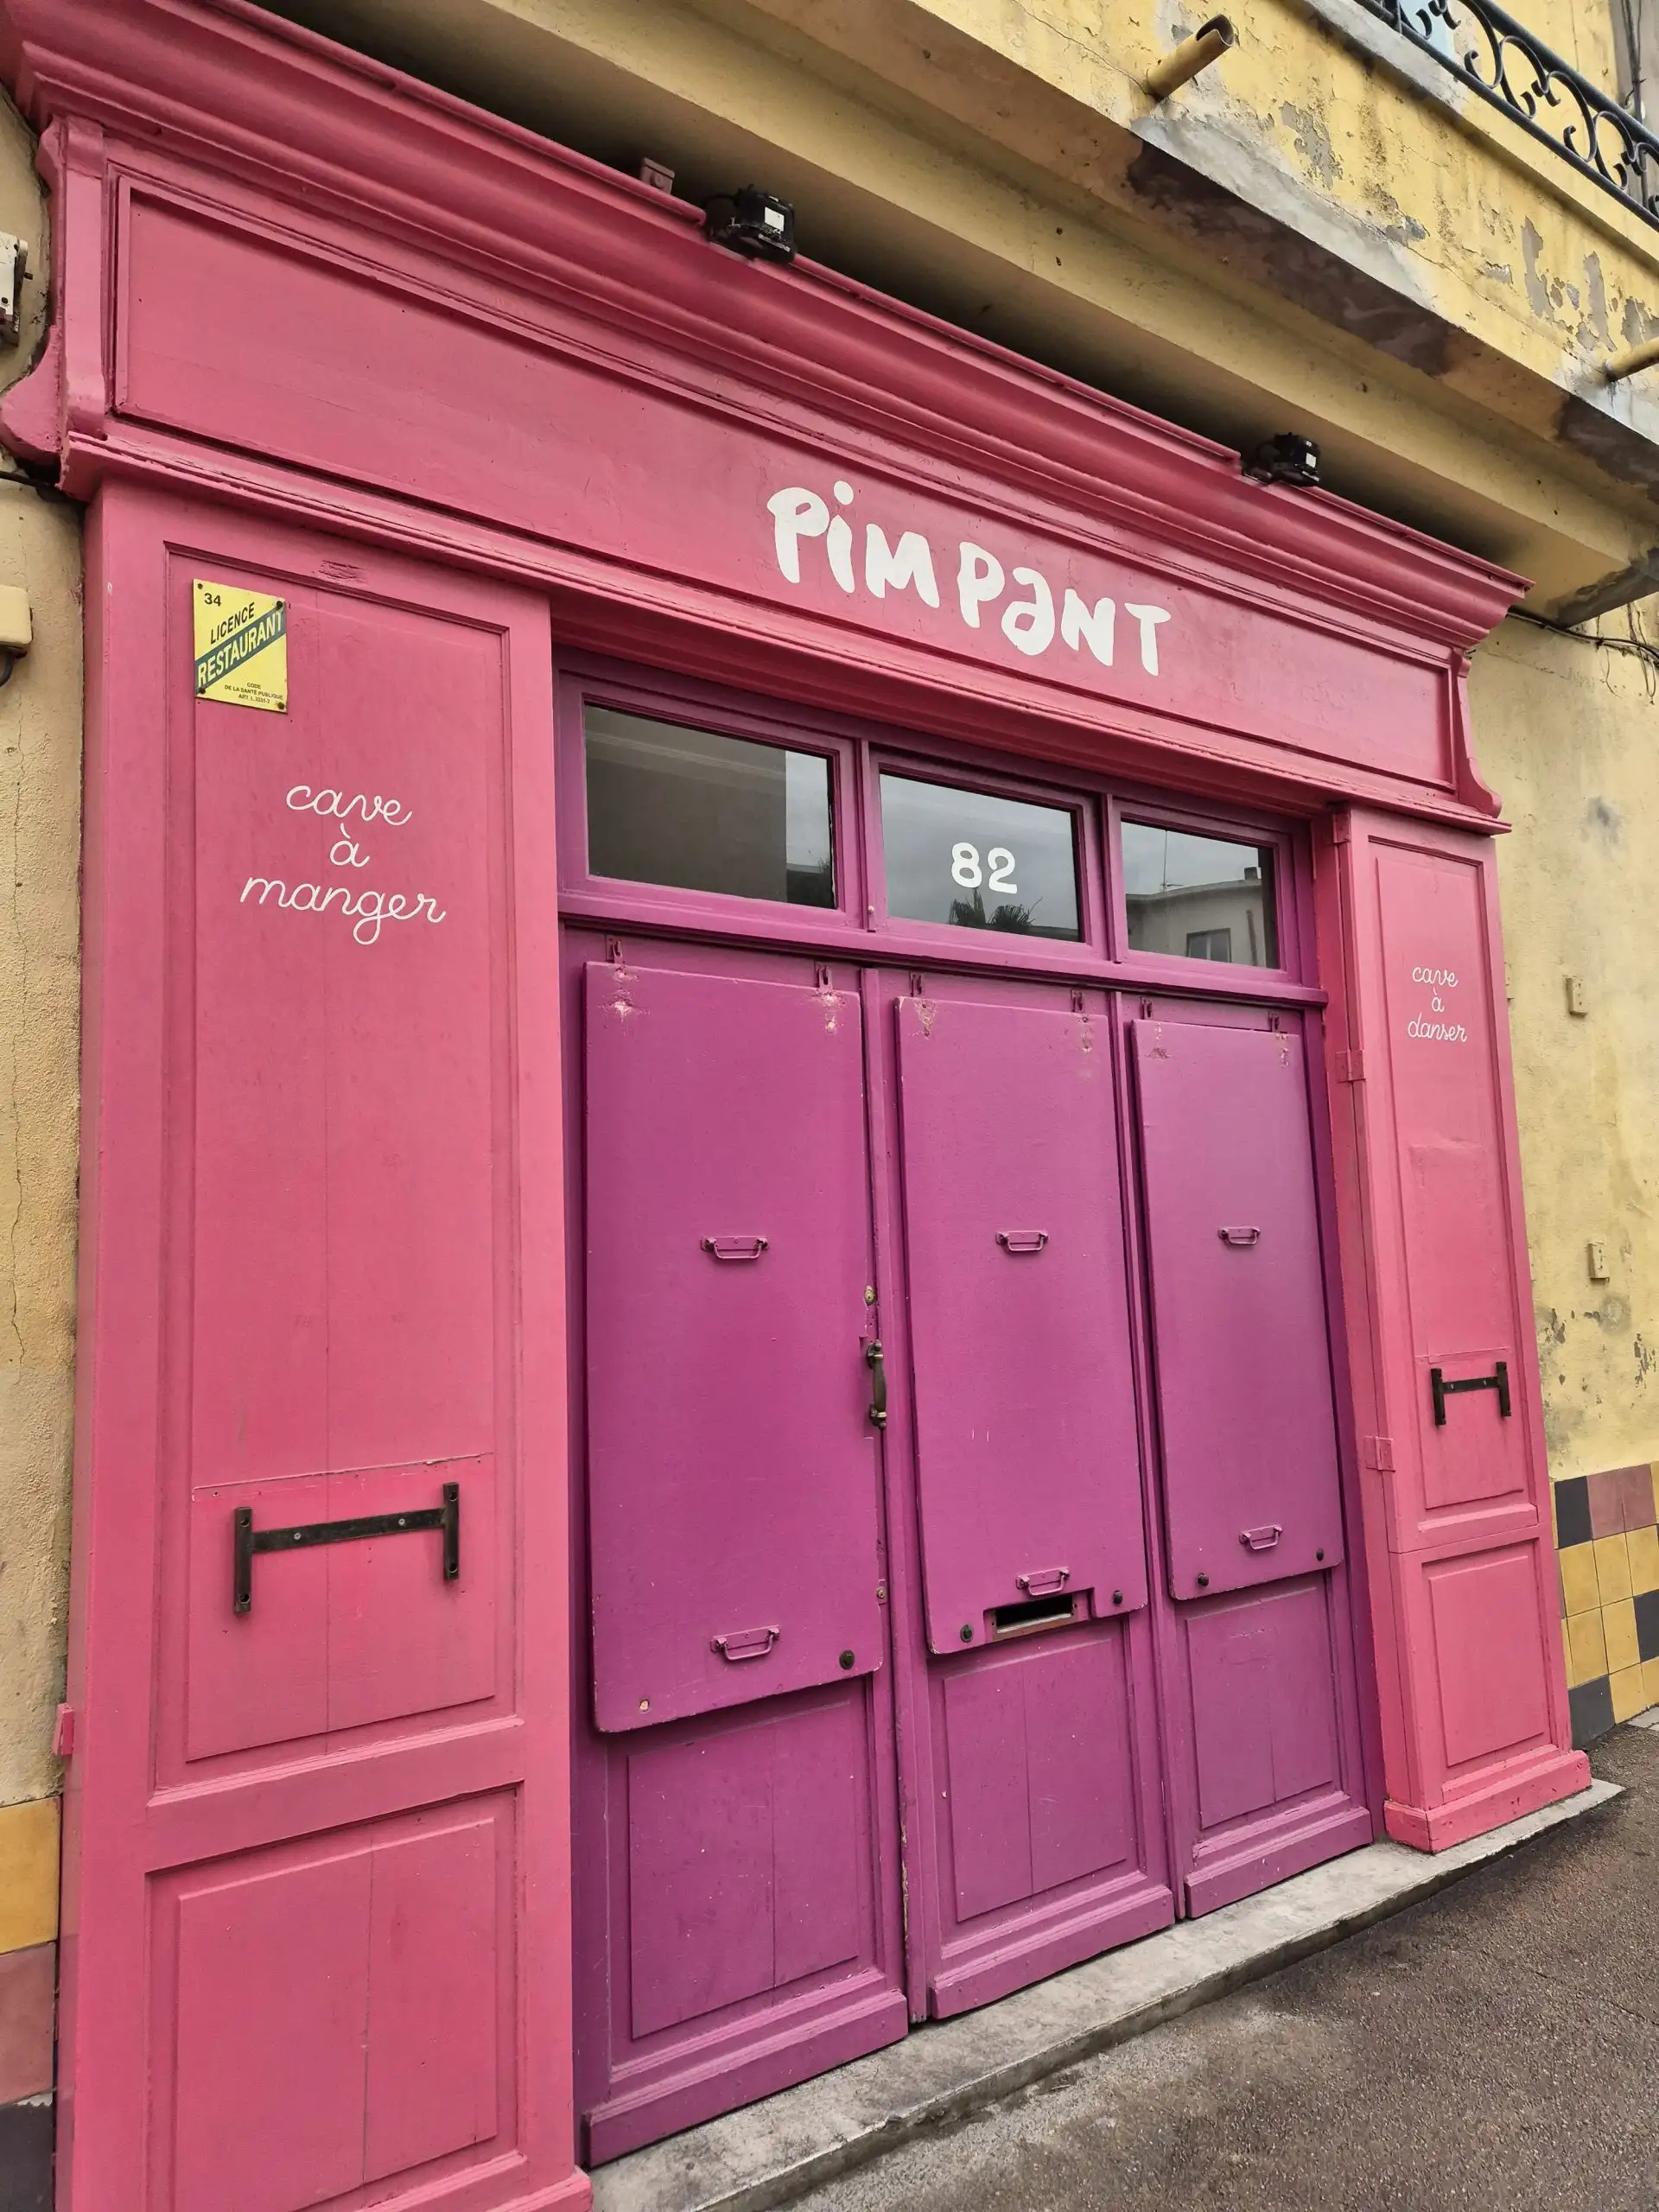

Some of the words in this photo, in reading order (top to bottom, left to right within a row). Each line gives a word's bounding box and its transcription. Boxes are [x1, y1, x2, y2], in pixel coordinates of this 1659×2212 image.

[204, 593, 222, 607] 34
[210, 601, 255, 645] LICENCE
[197, 610, 284, 688] RESTAURANT
[257, 690, 283, 701] PUBLIQUE
[286, 785, 413, 826] cave
[329, 822, 371, 868] à
[950, 842, 1018, 894] 82
[239, 876, 447, 945] manger
[1412, 966, 1459, 988] cave
[1431, 987, 1446, 1013] à
[1408, 1012, 1468, 1043] danser
